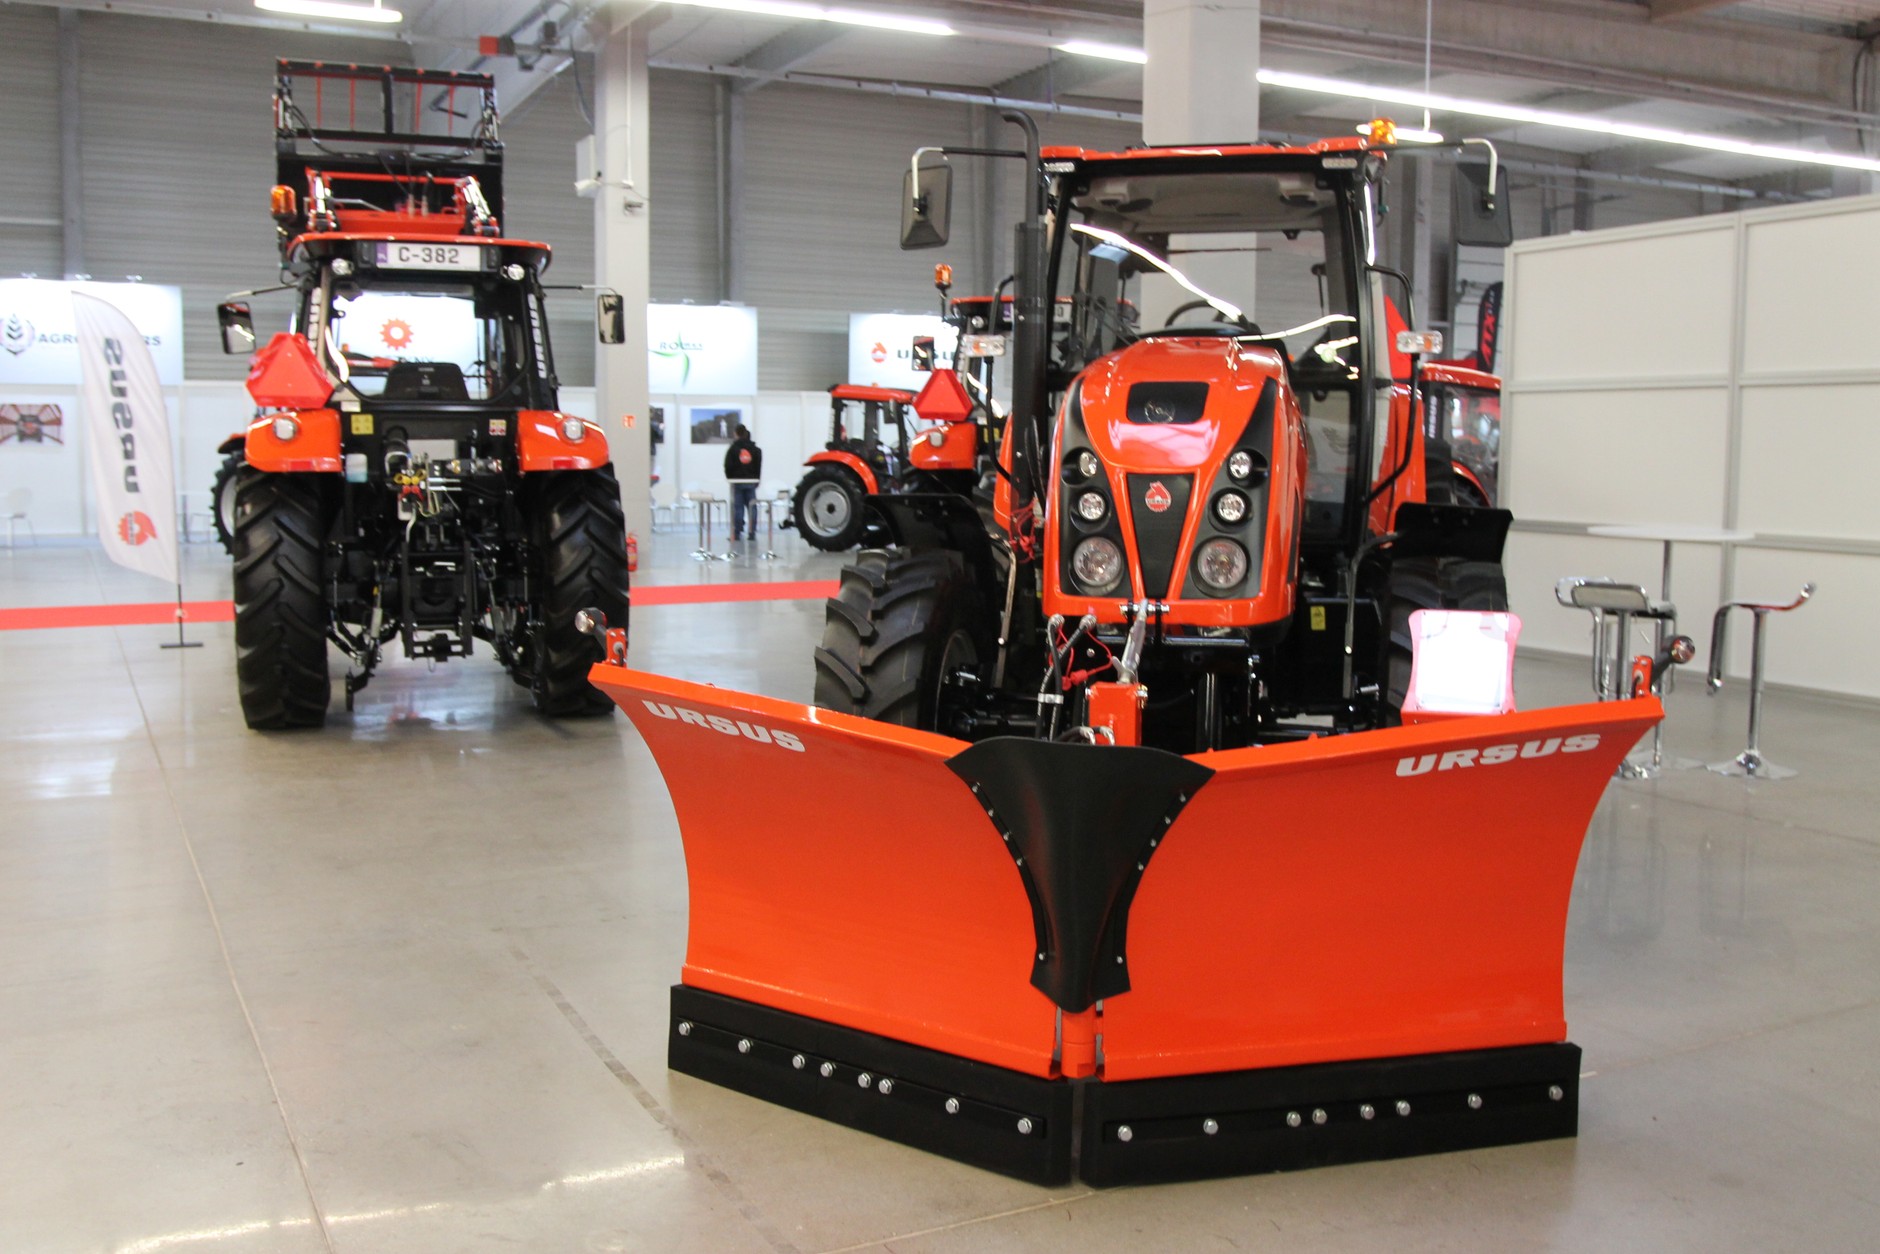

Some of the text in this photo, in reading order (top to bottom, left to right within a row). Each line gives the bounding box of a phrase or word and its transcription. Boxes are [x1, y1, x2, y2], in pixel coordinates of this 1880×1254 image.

[398, 246, 460, 264] C-382
[642, 700, 806, 753] URSUS
[1395, 733, 1601, 777] URSUS
